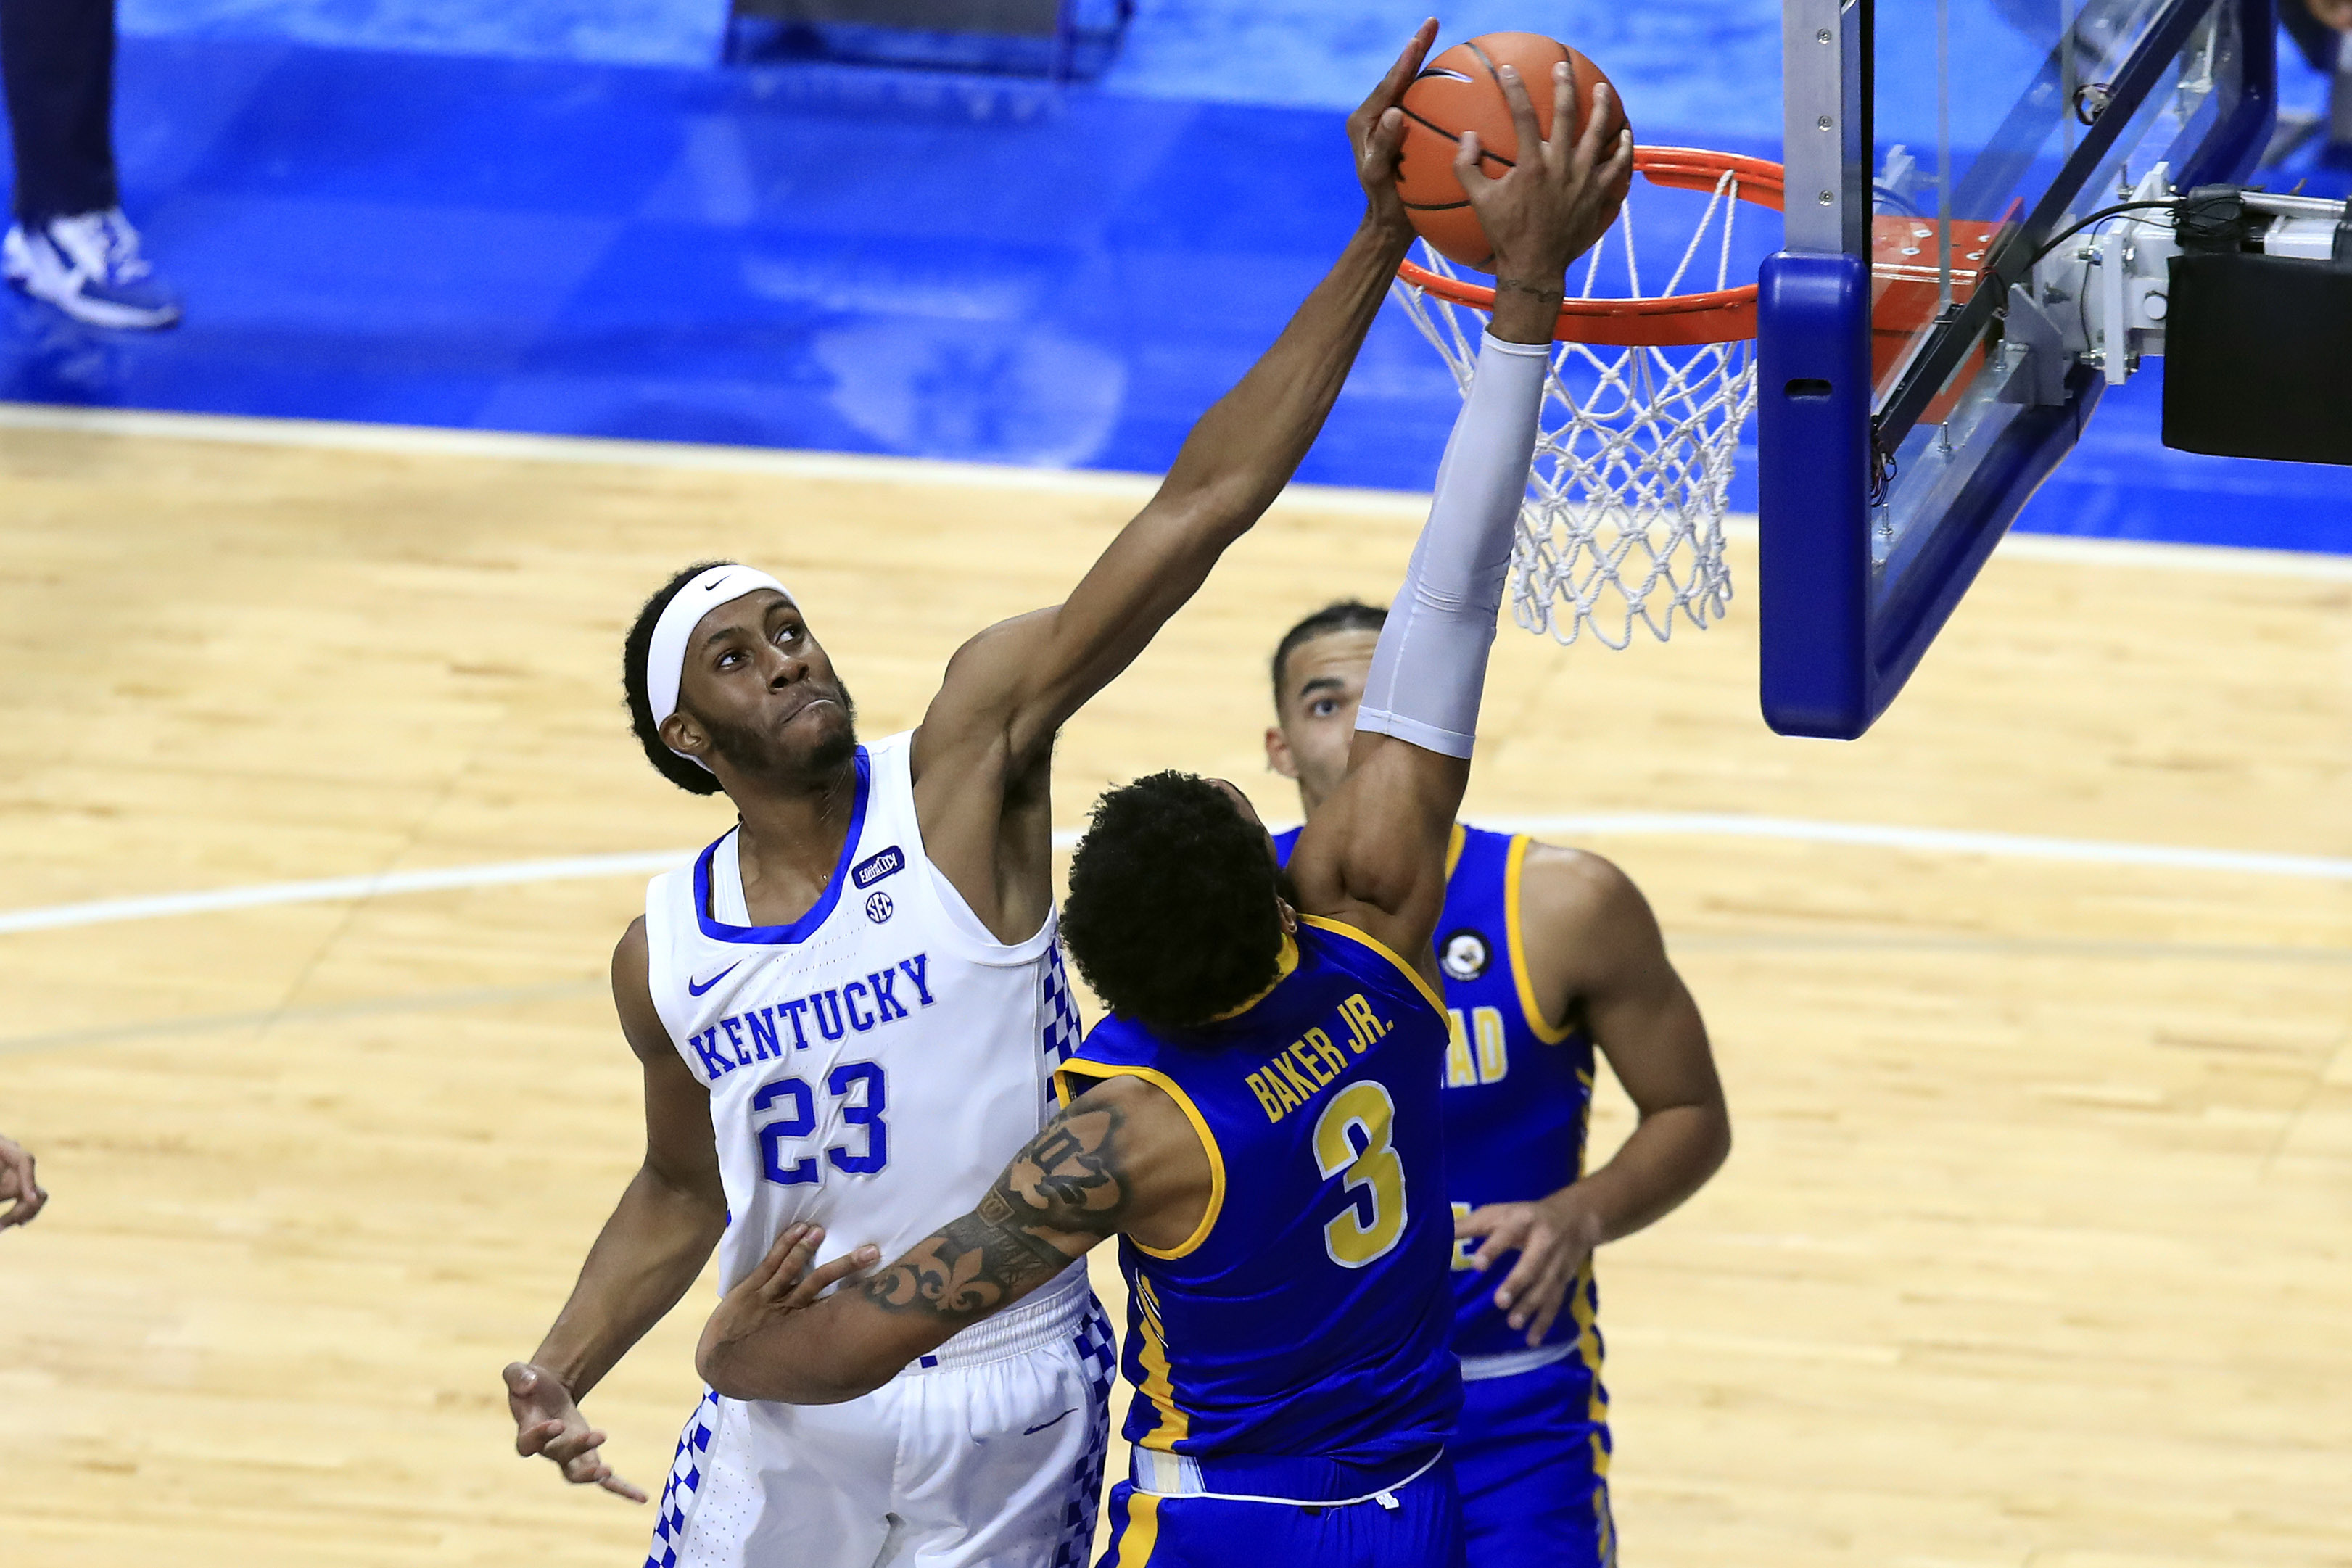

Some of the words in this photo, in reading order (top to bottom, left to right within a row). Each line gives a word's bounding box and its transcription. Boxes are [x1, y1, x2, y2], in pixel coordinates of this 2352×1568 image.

[867, 892, 892, 922] SEC
[688, 953, 935, 1081] KENTUCKY
[1245, 1026, 1349, 1123] BAKER
[1337, 993, 1394, 1054] JR.
[1441, 1005, 1508, 1089] AD
[751, 1058, 891, 1186] 23
[1312, 1079, 1408, 1268] 3
